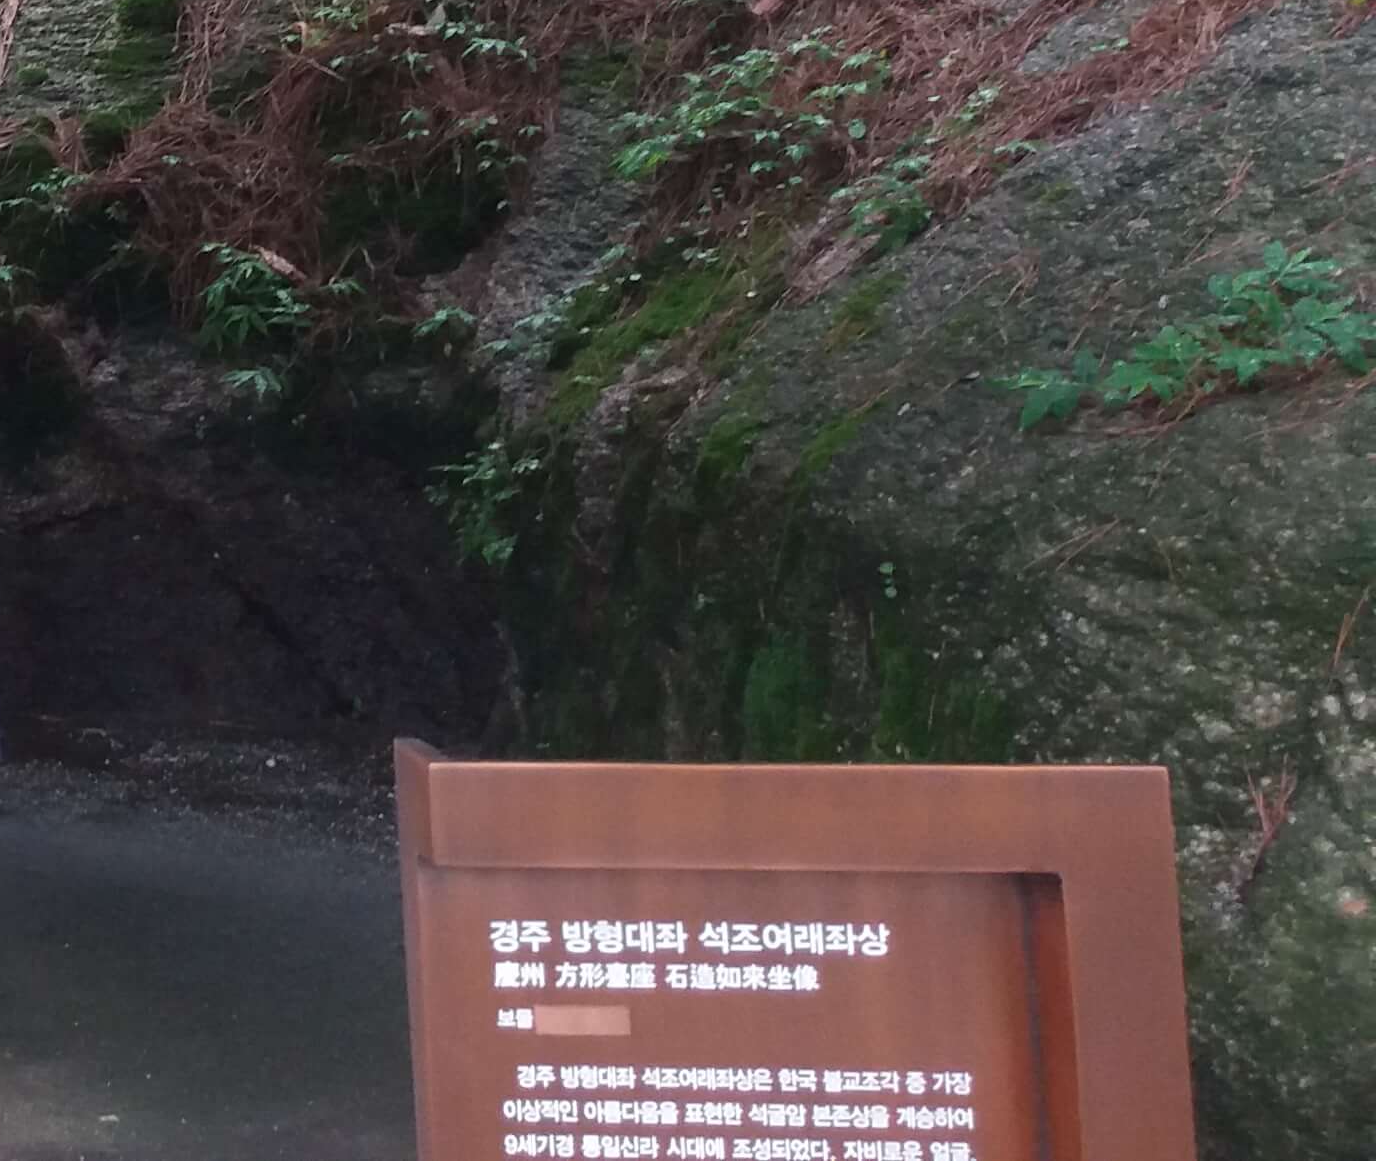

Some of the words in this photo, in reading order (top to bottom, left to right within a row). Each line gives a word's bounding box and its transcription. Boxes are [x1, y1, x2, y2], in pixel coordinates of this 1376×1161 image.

[490, 920, 551, 953] 경주
[562, 920, 688, 954] 방형대좌
[699, 922, 890, 956] 석조여래좌상
[518, 1065, 556, 1088] 경주
[560, 1066, 636, 1089] 방형대좌
[641, 1067, 773, 1091] 석조여래좌상은
[778, 1069, 817, 1092] 한국
[822, 1070, 900, 1093] 불교조각
[905, 1071, 926, 1094] 중
[933, 1072, 972, 1095] 가장
[503, 1099, 578, 1122] 이상적인
[584, 1101, 679, 1124] 아름다움을
[684, 1102, 743, 1125] 표현한
[748, 1103, 807, 1127] 석굴암
[812, 1105, 890, 1128] 본존상을
[897, 1106, 974, 1129] 계승하여
[504, 1134, 574, 1157] 9세기경
[581, 1135, 660, 1159] 통일신라
[667, 1137, 725, 1160] 시대에
[844, 1140, 923, 1161] 자비로운
